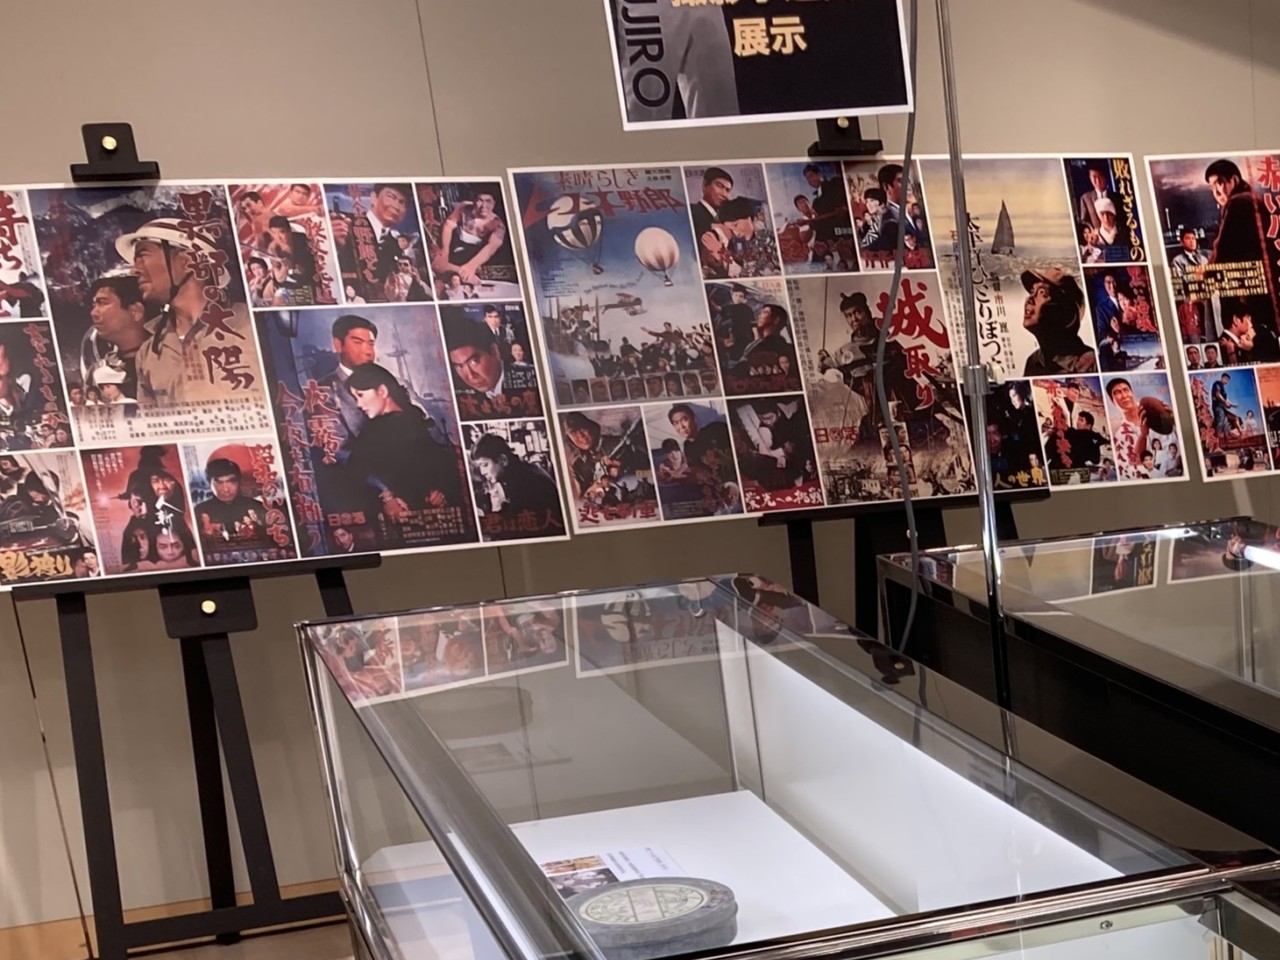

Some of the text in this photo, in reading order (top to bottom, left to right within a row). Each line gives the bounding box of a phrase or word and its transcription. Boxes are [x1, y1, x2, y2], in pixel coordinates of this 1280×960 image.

[621, 0, 671, 108] JIRO
[732, 16, 807, 57] 展示
[555, 168, 639, 191] 素晴らしき
[1113, 159, 1145, 262] 敗れざるもの
[177, 190, 256, 391] 黒部の太陽
[877, 277, 951, 411] 城取り
[251, 443, 289, 547] 昭和のいのち
[0, 551, 73, 580] 影狩り
